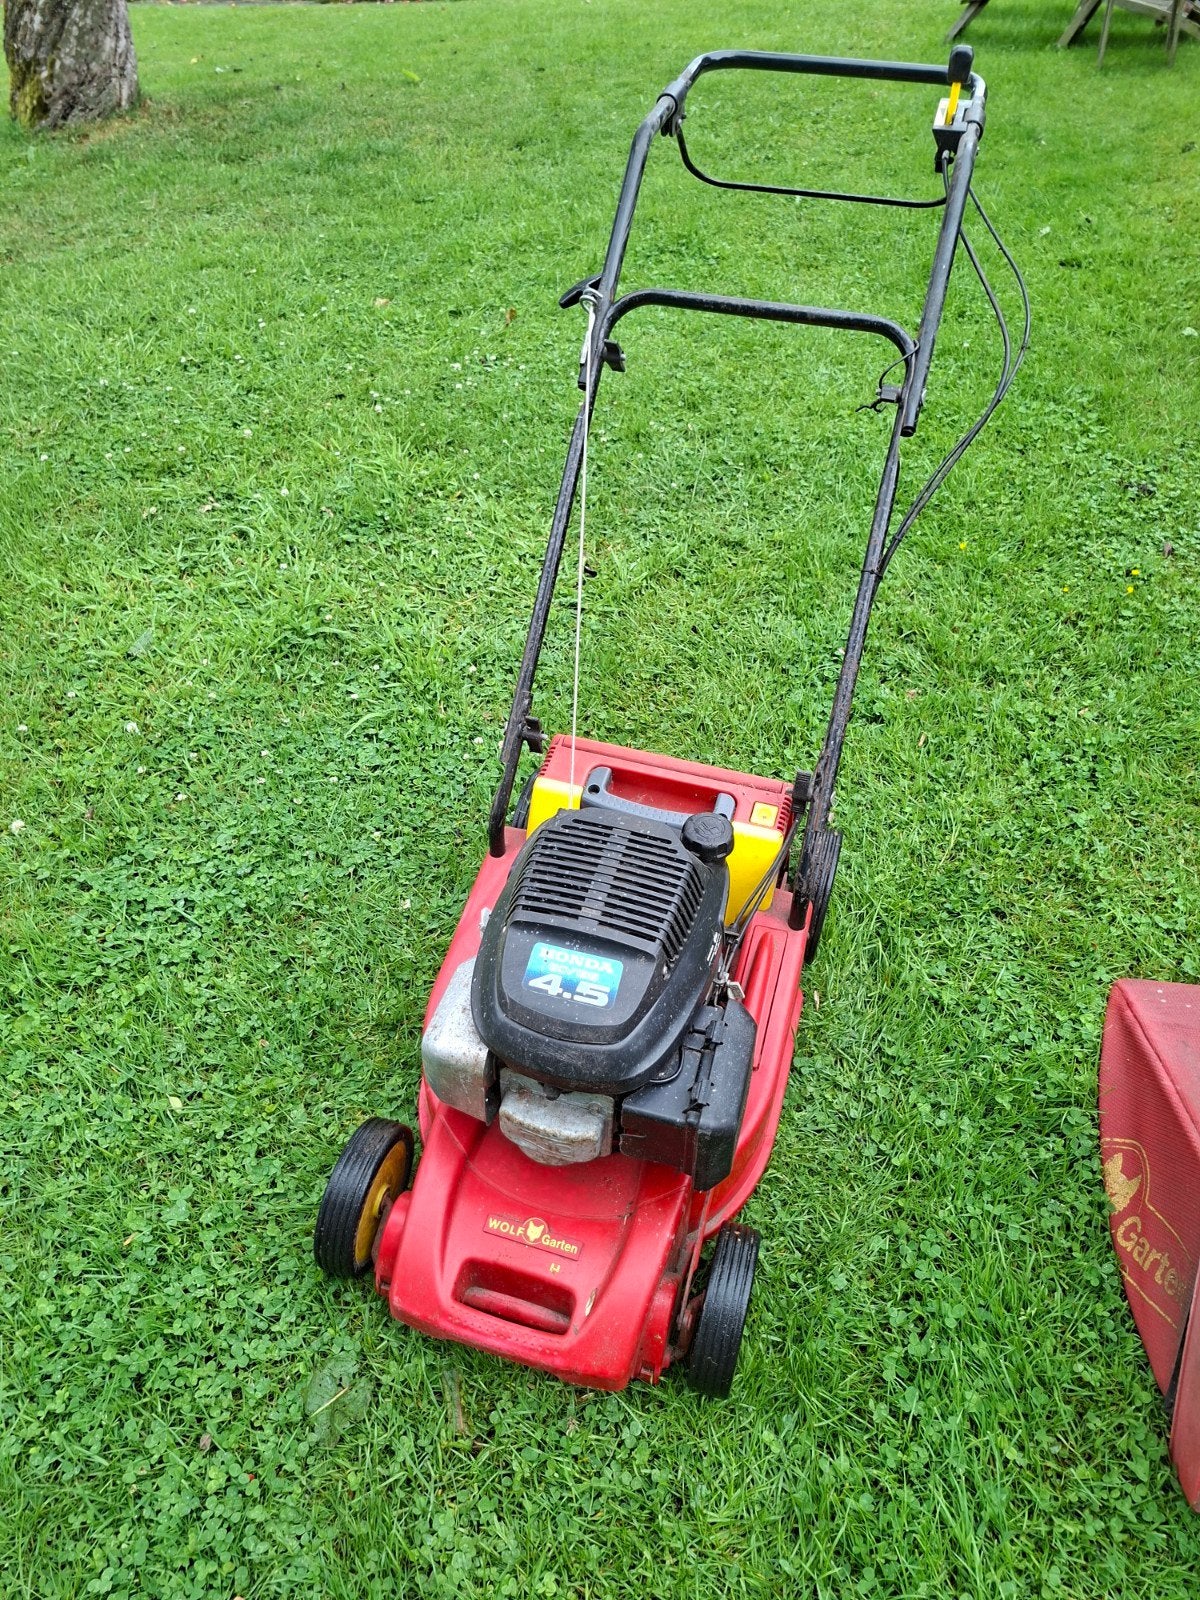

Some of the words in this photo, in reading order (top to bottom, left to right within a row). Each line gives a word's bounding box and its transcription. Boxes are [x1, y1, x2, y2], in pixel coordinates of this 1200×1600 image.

[540, 949, 613, 974] HONDA
[528, 973, 611, 1007] 4.5
[488, 1217, 525, 1237] WOLF
[541, 1234, 578, 1254] Garten
